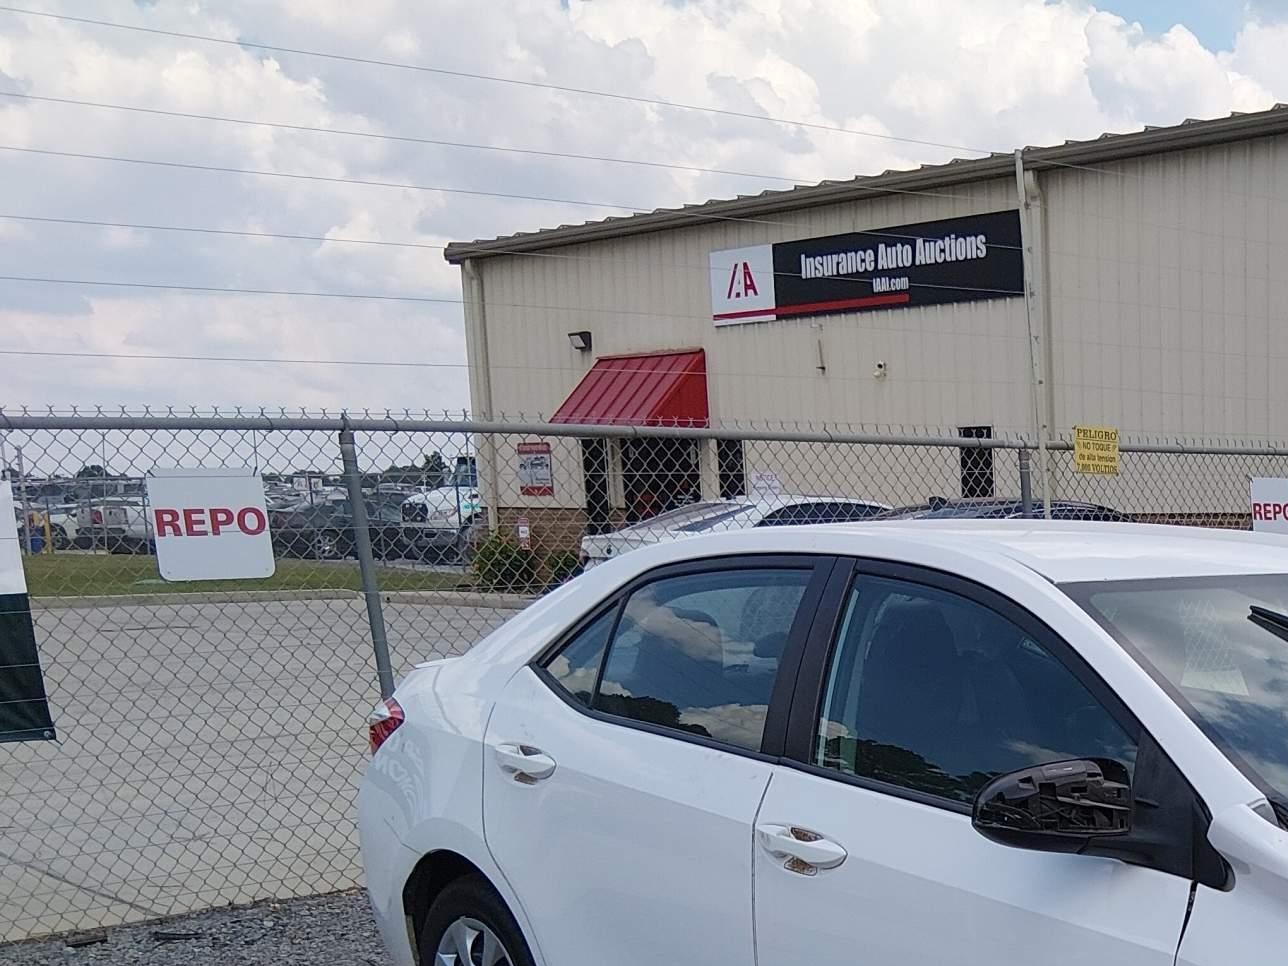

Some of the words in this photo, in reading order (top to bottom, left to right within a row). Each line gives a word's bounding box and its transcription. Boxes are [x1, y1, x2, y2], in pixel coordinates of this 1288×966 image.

[801, 248, 875, 279] Insurance
[877, 243, 913, 270] Auto
[915, 234, 987, 266] Auctions
[872, 276, 909, 293] IAAI.com
[1076, 428, 1117, 441] PELIGRO
[1082, 441, 1091, 450] NO
[1092, 442, 1112, 452] TOQUE
[1091, 463, 1118, 473] VOLTIOS
[154, 506, 266, 537] REPO
